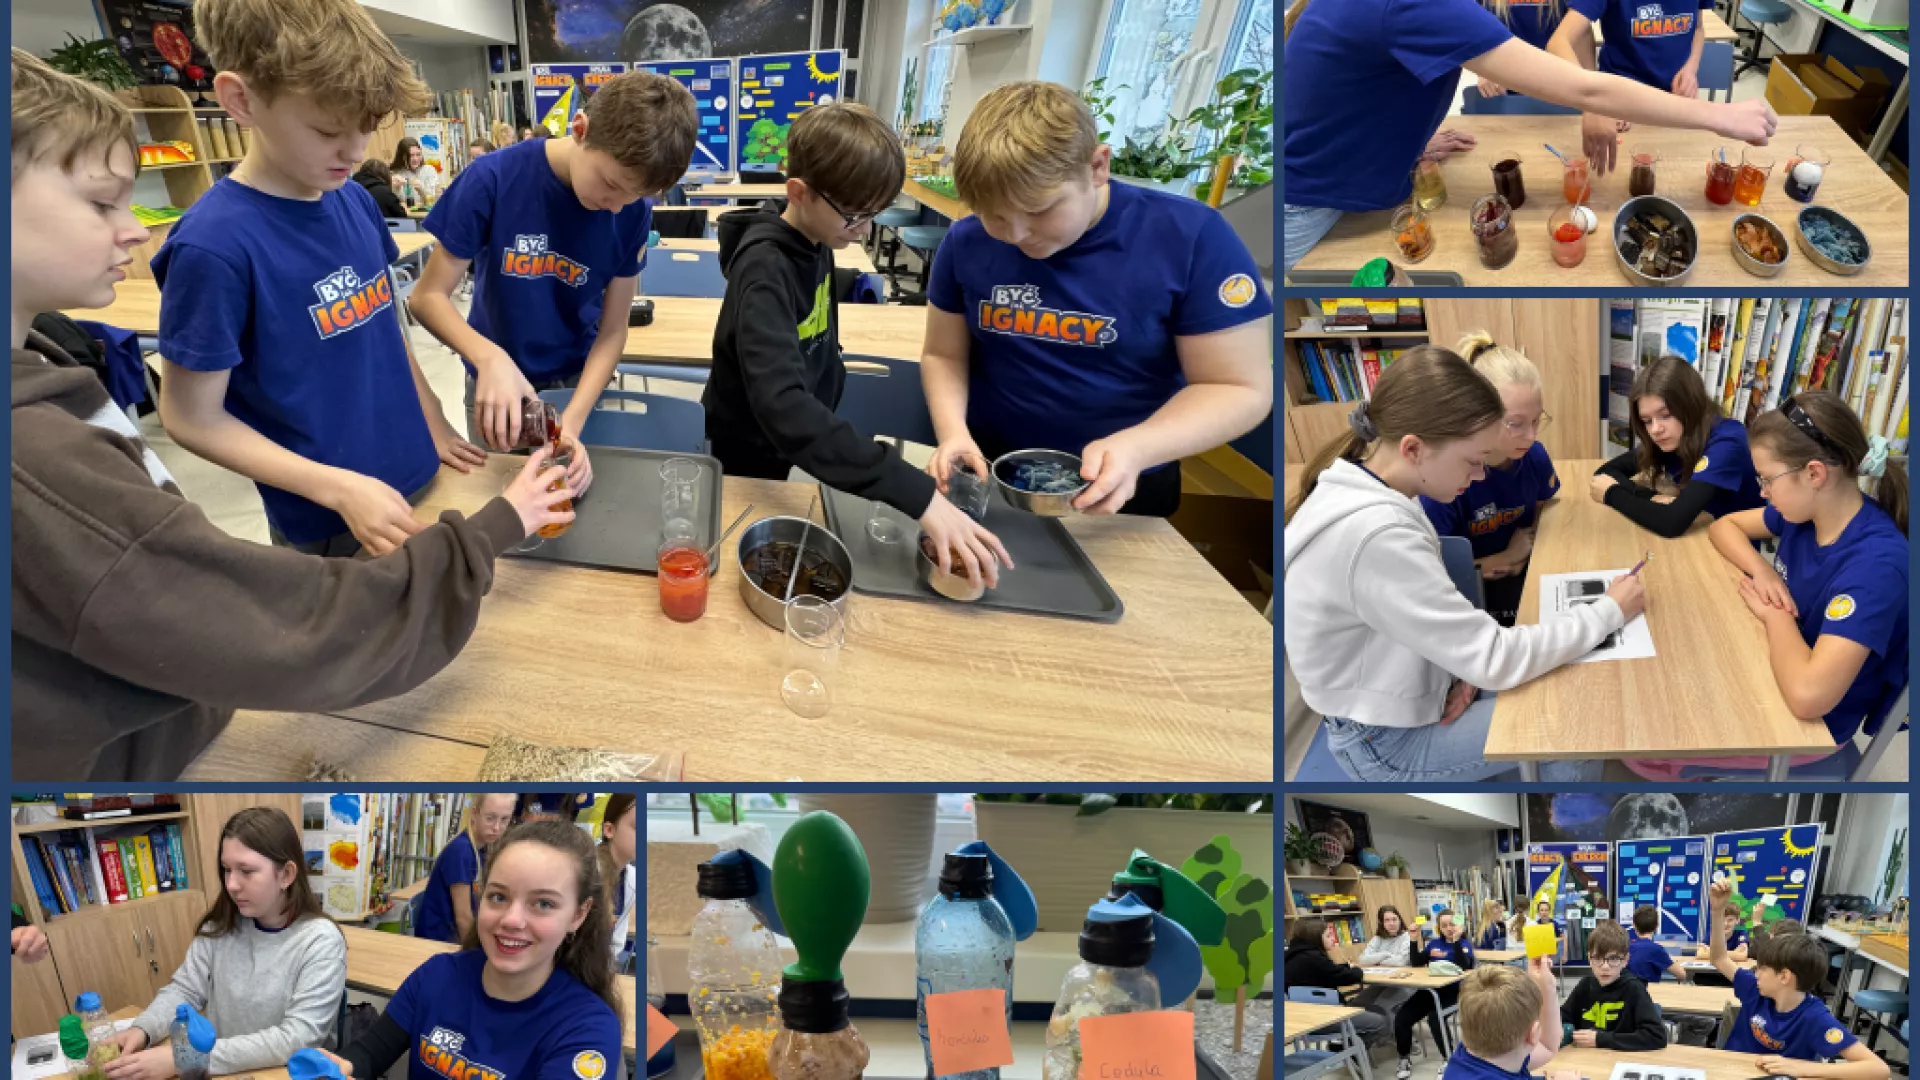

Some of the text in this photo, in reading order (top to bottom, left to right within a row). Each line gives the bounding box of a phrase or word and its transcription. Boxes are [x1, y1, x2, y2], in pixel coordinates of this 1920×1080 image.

[1634, 15, 1691, 36] IGNACY
[504, 252, 584, 285] IGNACY
[320, 269, 358, 303] BYĆ
[995, 286, 1035, 305] BYĆ
[316, 272, 391, 335] IGNAC
[982, 304, 1106, 344] IGNACY
[1582, 1001, 1624, 1029] 4F
